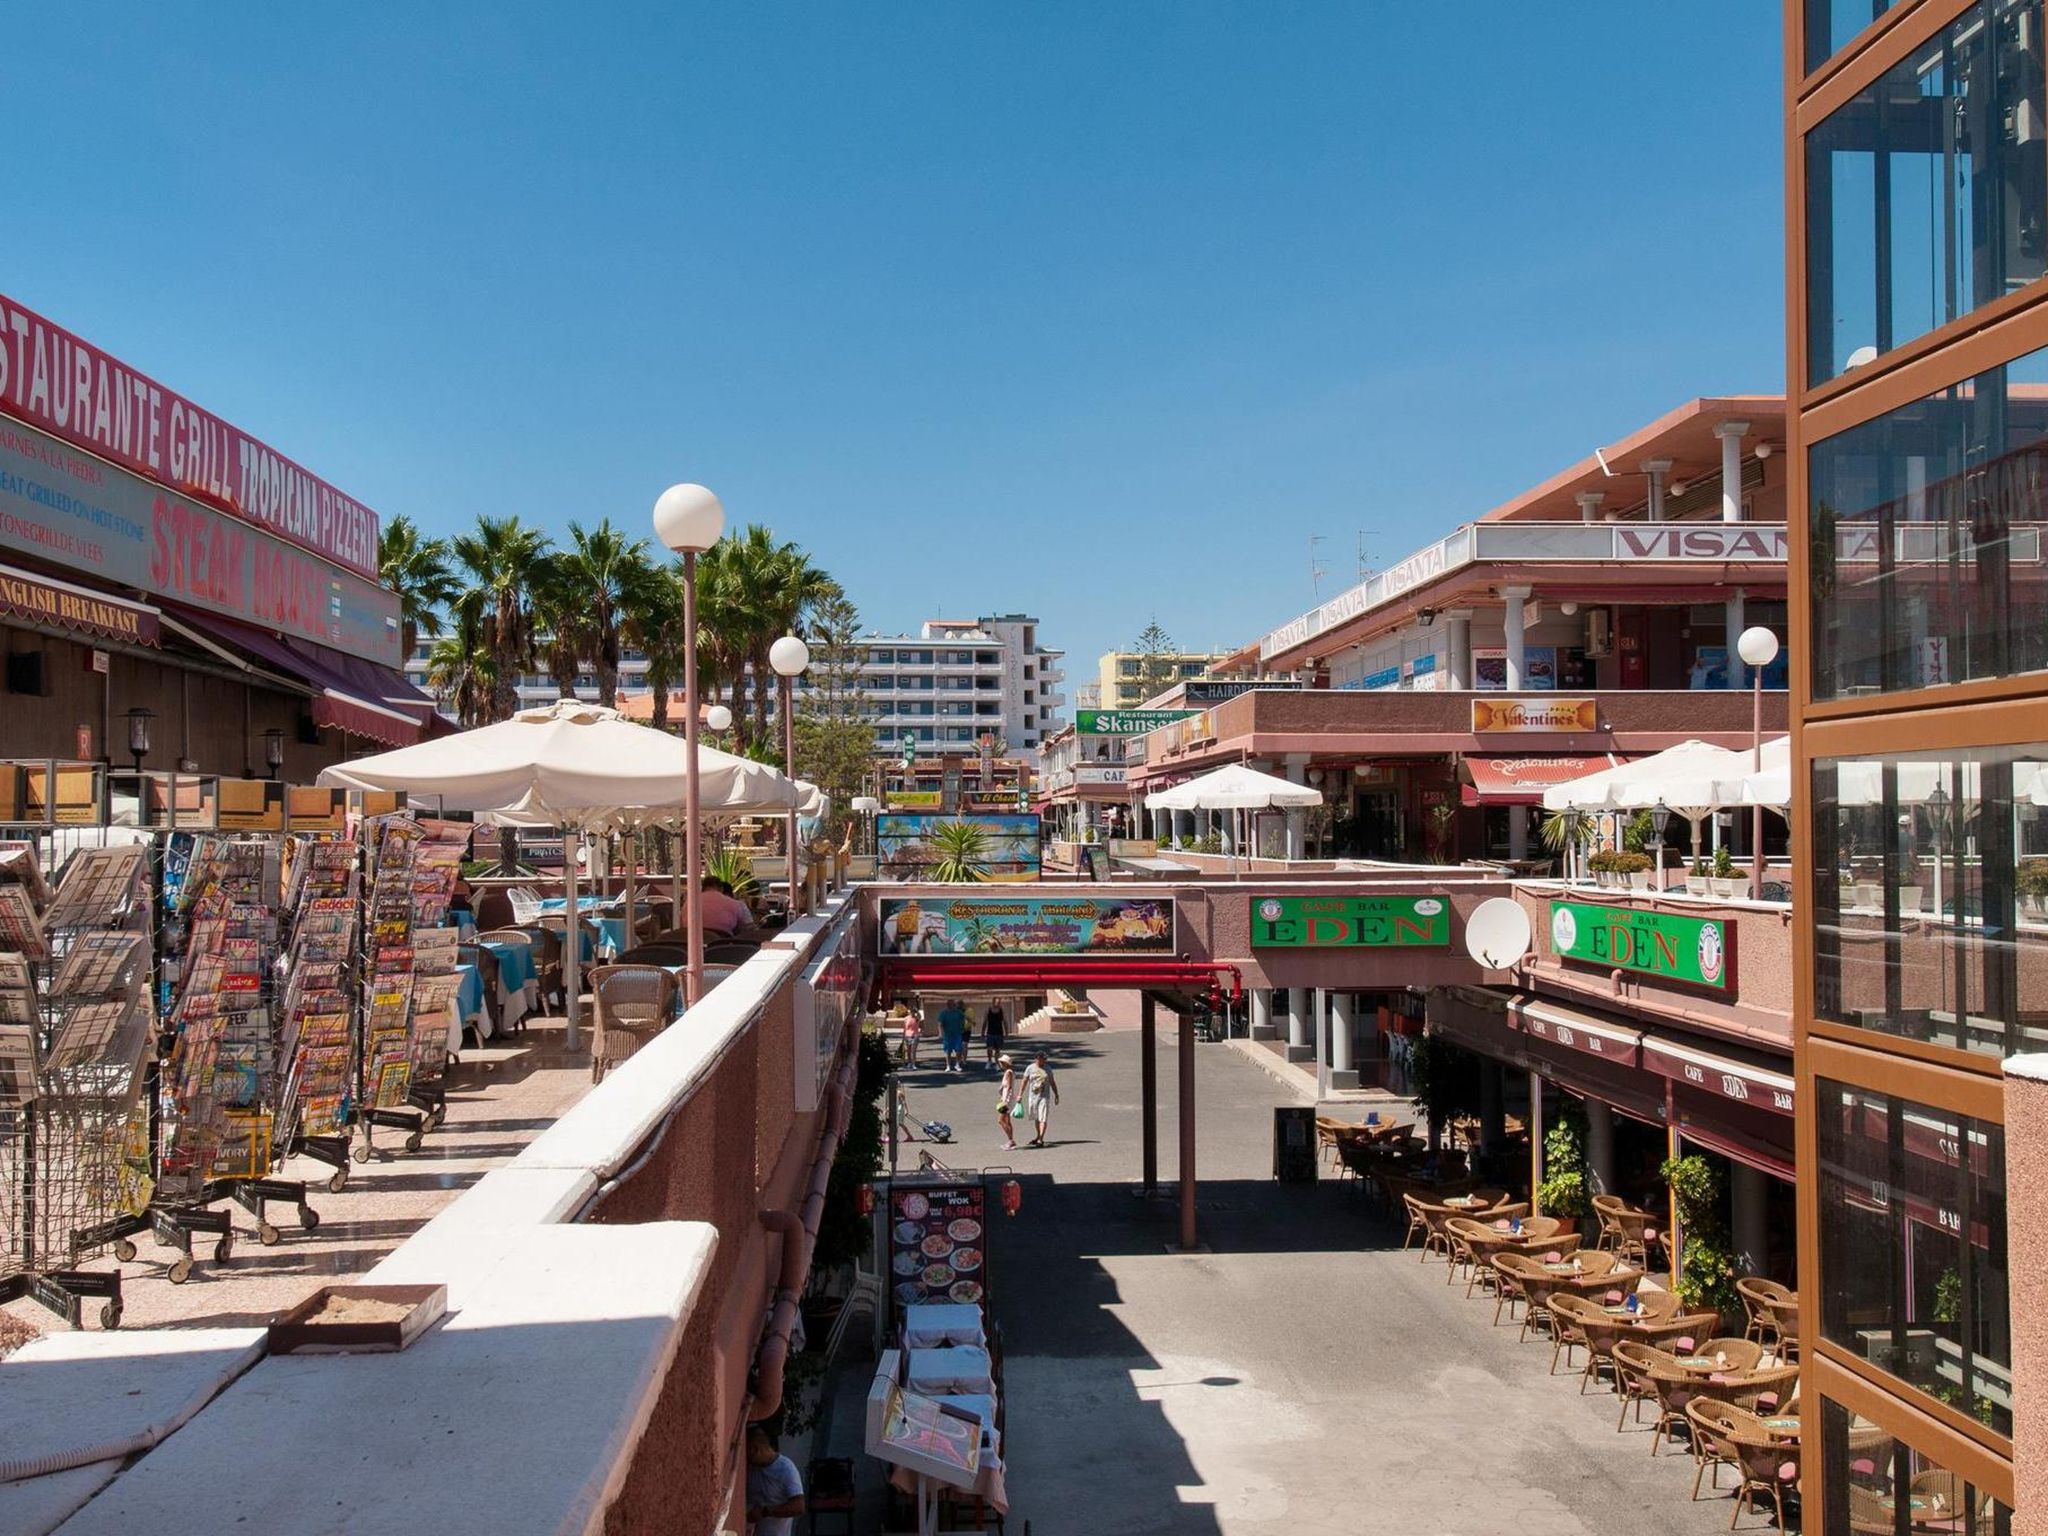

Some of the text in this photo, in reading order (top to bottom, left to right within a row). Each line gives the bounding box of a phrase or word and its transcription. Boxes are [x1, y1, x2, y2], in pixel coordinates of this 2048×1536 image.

[170, 399, 233, 501] GRILL
[239, 437, 319, 546] TROPICANA
[321, 486, 379, 573] PIZZERIA
[151, 493, 328, 638] STEAK HOUSE
[1382, 545, 1443, 595] VISANTA
[60, 593, 139, 635] BREAKFAST
[1320, 588, 1365, 628] VISANTA
[1493, 704, 1575, 727] Valentines
[1358, 902, 1391, 912] BAR
[1638, 915, 1660, 927] BAR
[1263, 917, 1438, 945] EDEN
[1591, 924, 1679, 970] EDEN
[1556, 1025, 1575, 1046] EDEN
[1721, 1074, 1749, 1099] EDEN
[1773, 1091, 1793, 1111] BAR
[948, 1197, 970, 1205] WOK
